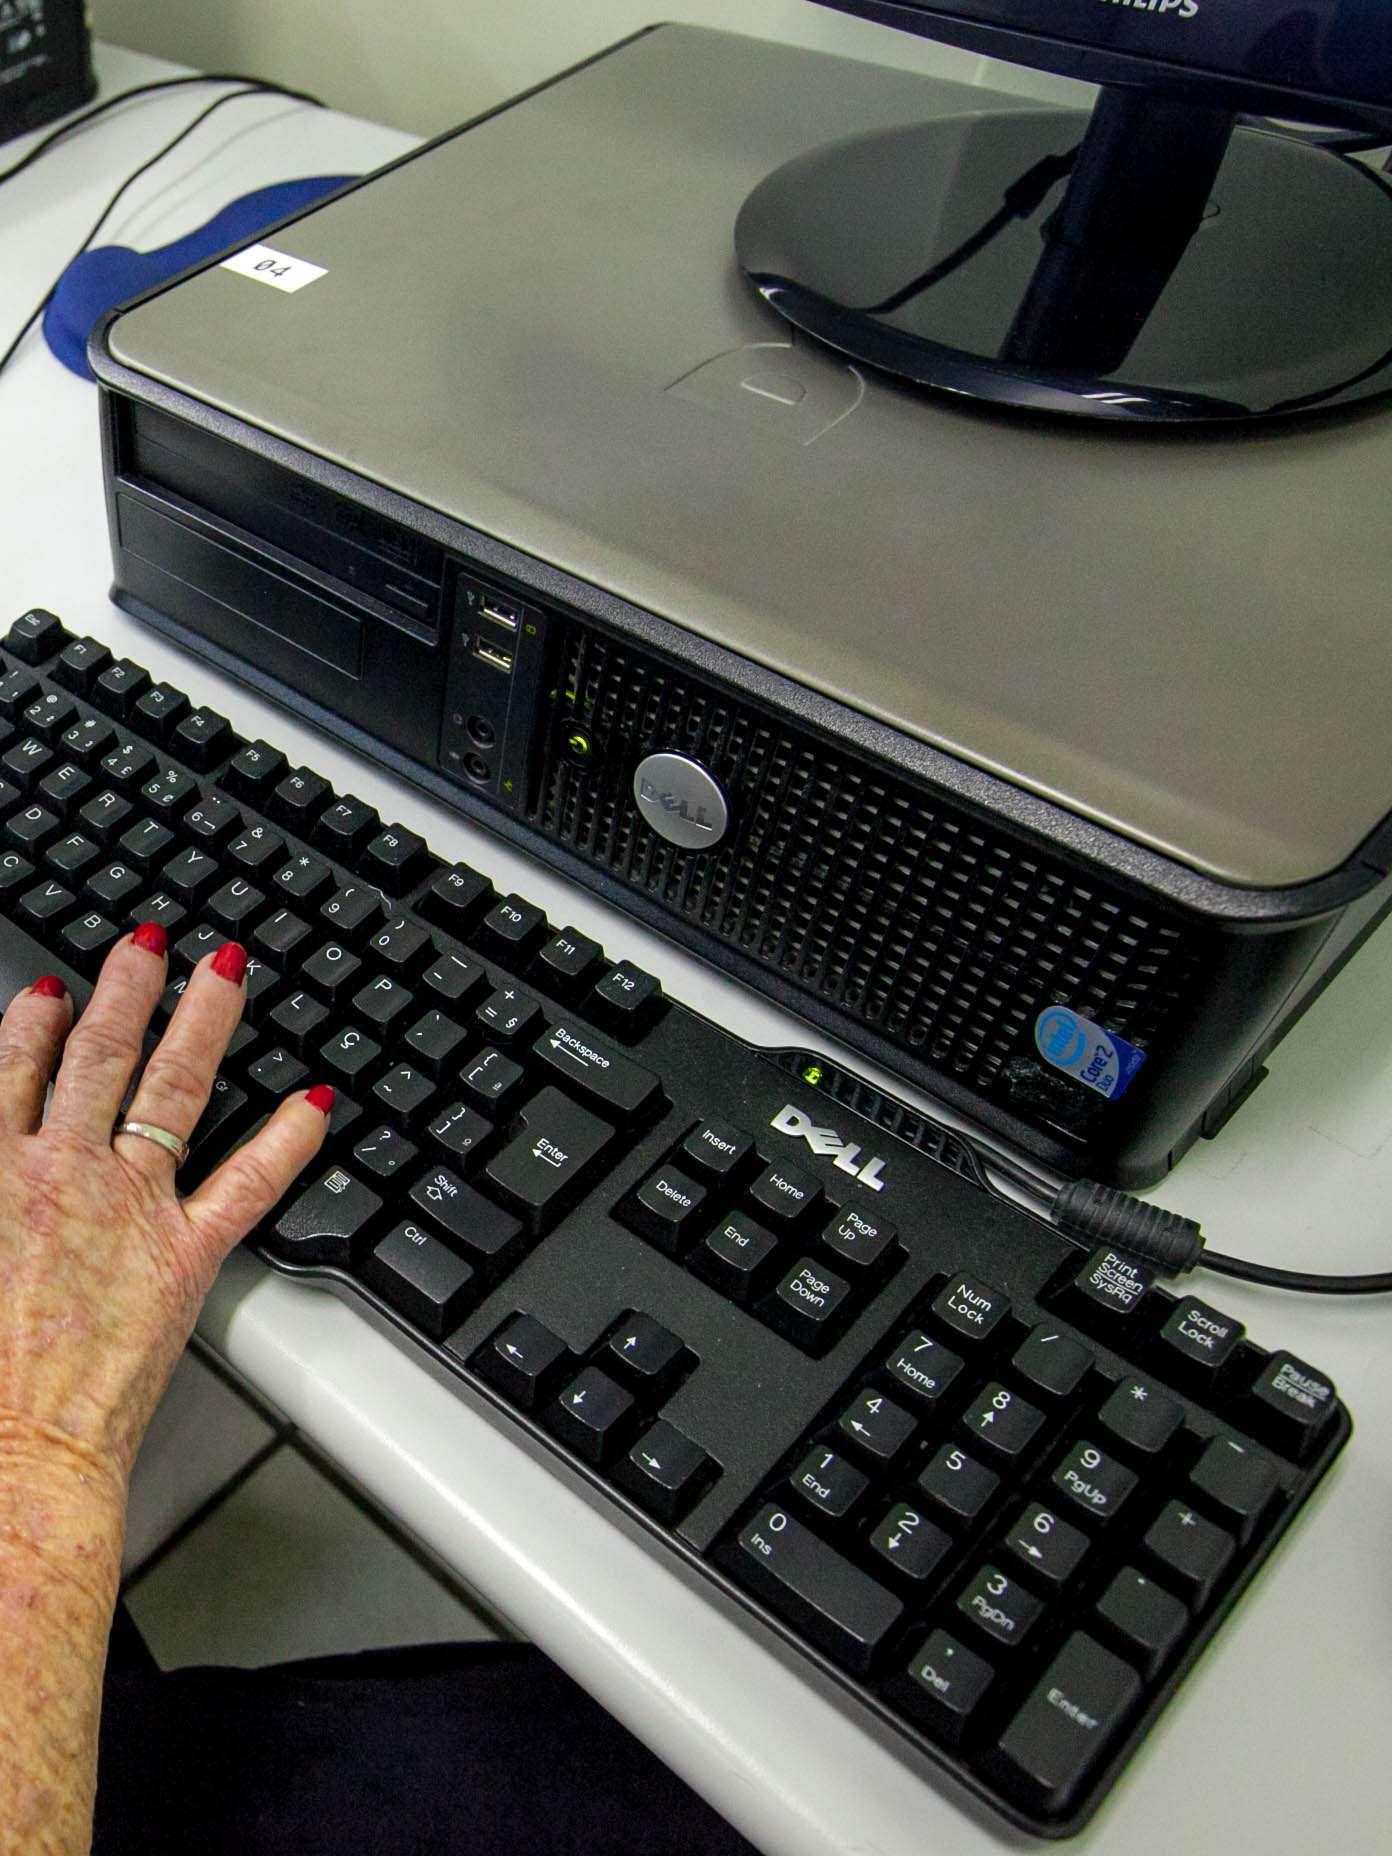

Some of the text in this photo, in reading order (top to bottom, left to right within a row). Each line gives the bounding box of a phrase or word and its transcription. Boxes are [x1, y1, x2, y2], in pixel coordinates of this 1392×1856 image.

[253, 259, 292, 277] 04
[25, 614, 40, 626] Esc
[74, 644, 86, 654] F1
[112, 667, 125, 678] F2
[150, 691, 164, 702] F3
[30, 706, 41, 715] 2
[191, 716, 204, 726] F4
[68, 731, 79, 739] 3
[23, 741, 42, 755] W
[246, 750, 260, 761] F5
[58, 767, 75, 780] E
[166, 771, 177, 783] %
[149, 784, 160, 793] 5
[290, 777, 304, 788] F6
[99, 793, 115, 807] R
[25, 808, 41, 819] D
[192, 812, 203, 821] 6
[336, 805, 352, 816] F7
[144, 821, 158, 832] T
[252, 828, 263, 838] &
[67, 836, 84, 845] F
[236, 841, 247, 849] 7
[383, 835, 398, 846] F8
[4, 856, 18, 867] C
[188, 851, 203, 863] Y
[110, 867, 125, 878] G
[282, 871, 293, 880] 8
[448, 874, 464, 886] F9
[46, 884, 62, 895] V
[232, 882, 248, 895] U
[152, 896, 169, 910] H
[329, 903, 339, 913] 9
[84, 915, 101, 928] B
[275, 913, 287, 922] I
[501, 906, 521, 922] F10
[327, 948, 341, 960] O
[556, 939, 575, 955] F11
[247, 960, 261, 975] K
[375, 979, 392, 989] P
[613, 973, 634, 990] F12
[291, 994, 303, 1009] L
[341, 1032, 359, 1048] Ç
[555, 1028, 611, 1069] Backspace
[1080, 1056, 1108, 1083] Core
[536, 1137, 569, 1163] Enter
[703, 1130, 736, 1154] Insert
[770, 1103, 886, 1192] DELL
[434, 1175, 458, 1198] Shift
[656, 1180, 691, 1206] Delete
[770, 1174, 804, 1199] Home
[838, 1225, 855, 1241] Up
[847, 1212, 877, 1238] Page
[405, 1227, 427, 1245] Ctrl
[724, 1226, 749, 1246] End
[1104, 1253, 1139, 1279] Print
[799, 1268, 829, 1294] Page
[1098, 1262, 1144, 1293] Screen
[790, 1279, 825, 1308] Down
[1089, 1273, 1132, 1304] SysRq
[957, 1284, 992, 1312] Num
[948, 1296, 985, 1325] Lock
[1188, 1310, 1229, 1338] Scroll
[1178, 1320, 1215, 1348] Lock
[914, 1336, 933, 1351] 7
[897, 1358, 936, 1389] Home
[1279, 1363, 1330, 1396] Pause
[1271, 1374, 1315, 1408] Break
[867, 1399, 882, 1413] 4
[993, 1392, 1010, 1409] 8
[821, 1454, 833, 1468] 1
[946, 1451, 965, 1470] 5
[1080, 1449, 1100, 1468] 9
[802, 1474, 830, 1498] End
[1064, 1470, 1106, 1506] PgUp
[898, 1512, 919, 1534] 2
[1034, 1513, 1054, 1533] 6
[751, 1534, 772, 1555] Ins
[987, 1574, 1007, 1595] 3
[972, 1595, 1015, 1631] PgDn
[921, 1665, 950, 1692] Del
[1047, 1688, 1098, 1729] Enter
